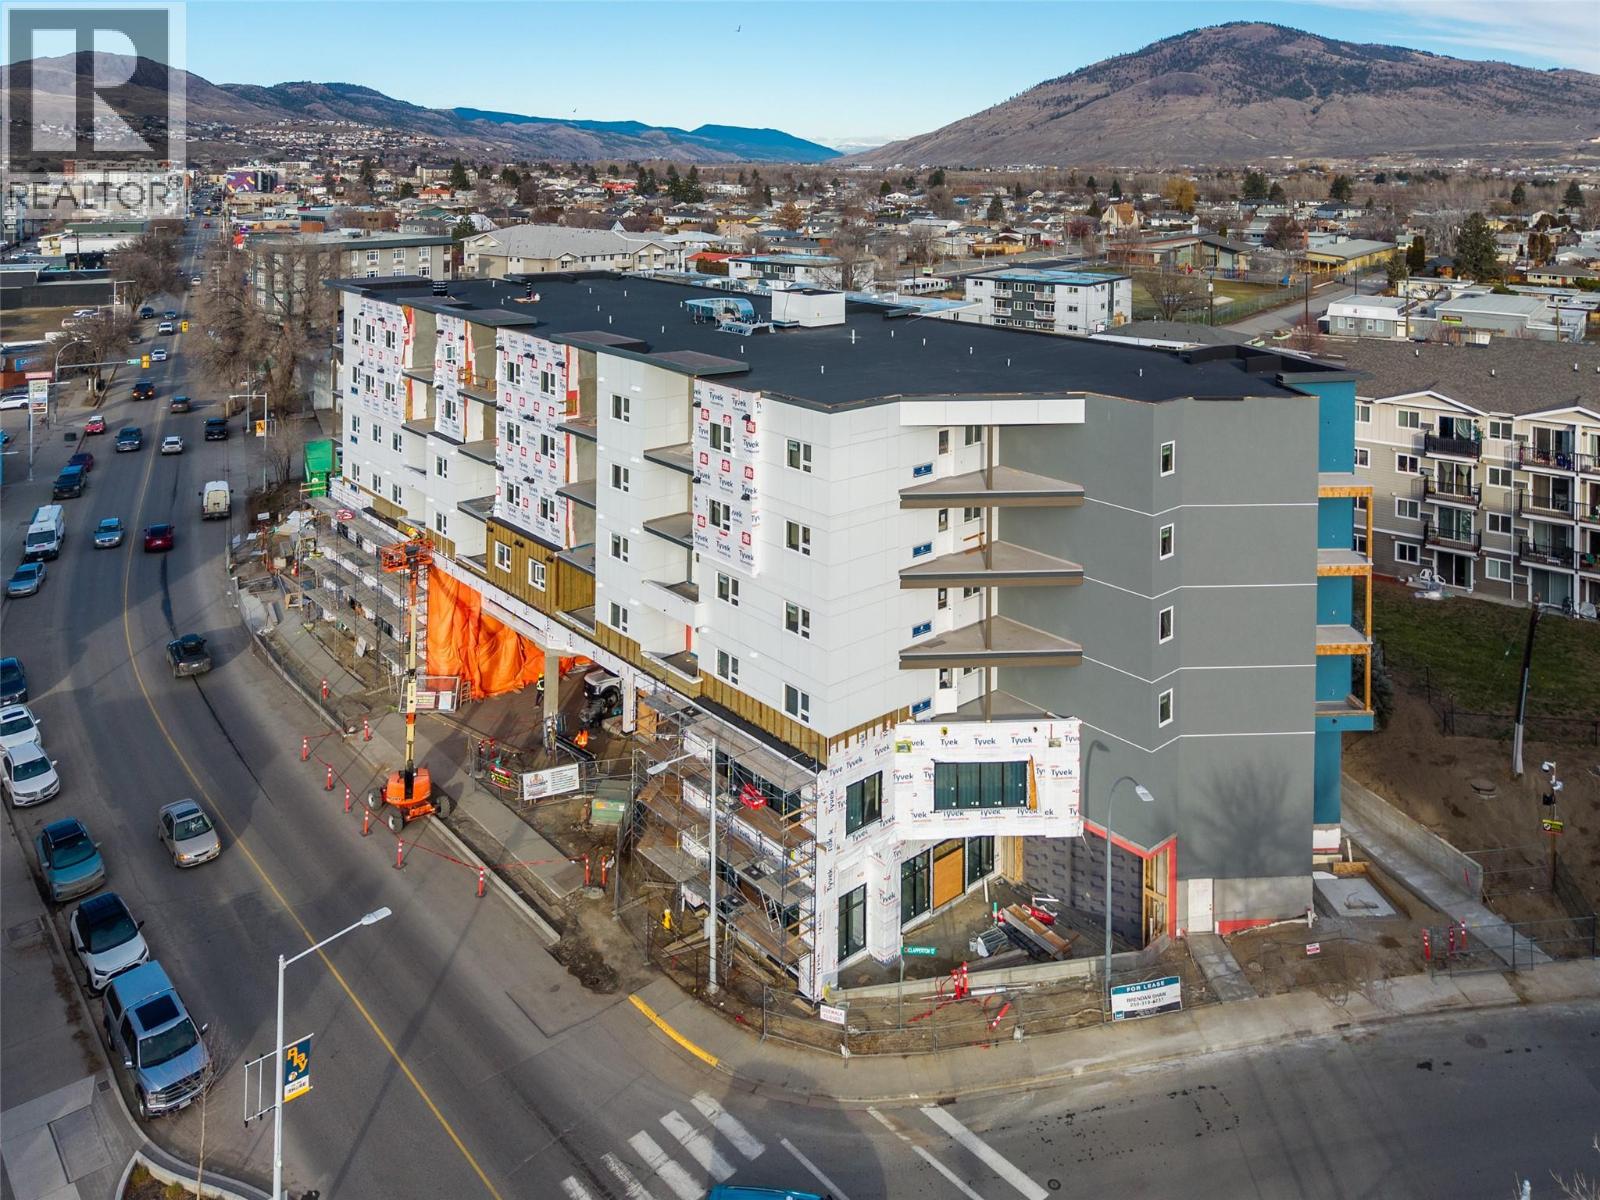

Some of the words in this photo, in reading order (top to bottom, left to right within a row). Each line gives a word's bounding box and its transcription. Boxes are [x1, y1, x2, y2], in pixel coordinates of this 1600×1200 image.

[708, 392, 724, 401] Tyvek
[743, 438, 759, 448] Tyvek
[719, 477, 733, 488] Tyvek
[741, 485, 758, 494] Tyvek
[694, 532, 709, 543] Tyvek
[716, 540, 731, 552] Tyvek
[739, 549, 754, 561] Tyvek
[974, 737, 997, 746] Tyvek
[1011, 736, 1033, 745] Tyvek
[874, 743, 890, 757] Tyvek
[846, 756, 863, 769] Tyvek
[893, 773, 913, 782] Tyvek
[1051, 769, 1073, 777] Tyvek
[879, 815, 896, 829] Tyvek
[1143, 981, 1165, 989] LEASE
